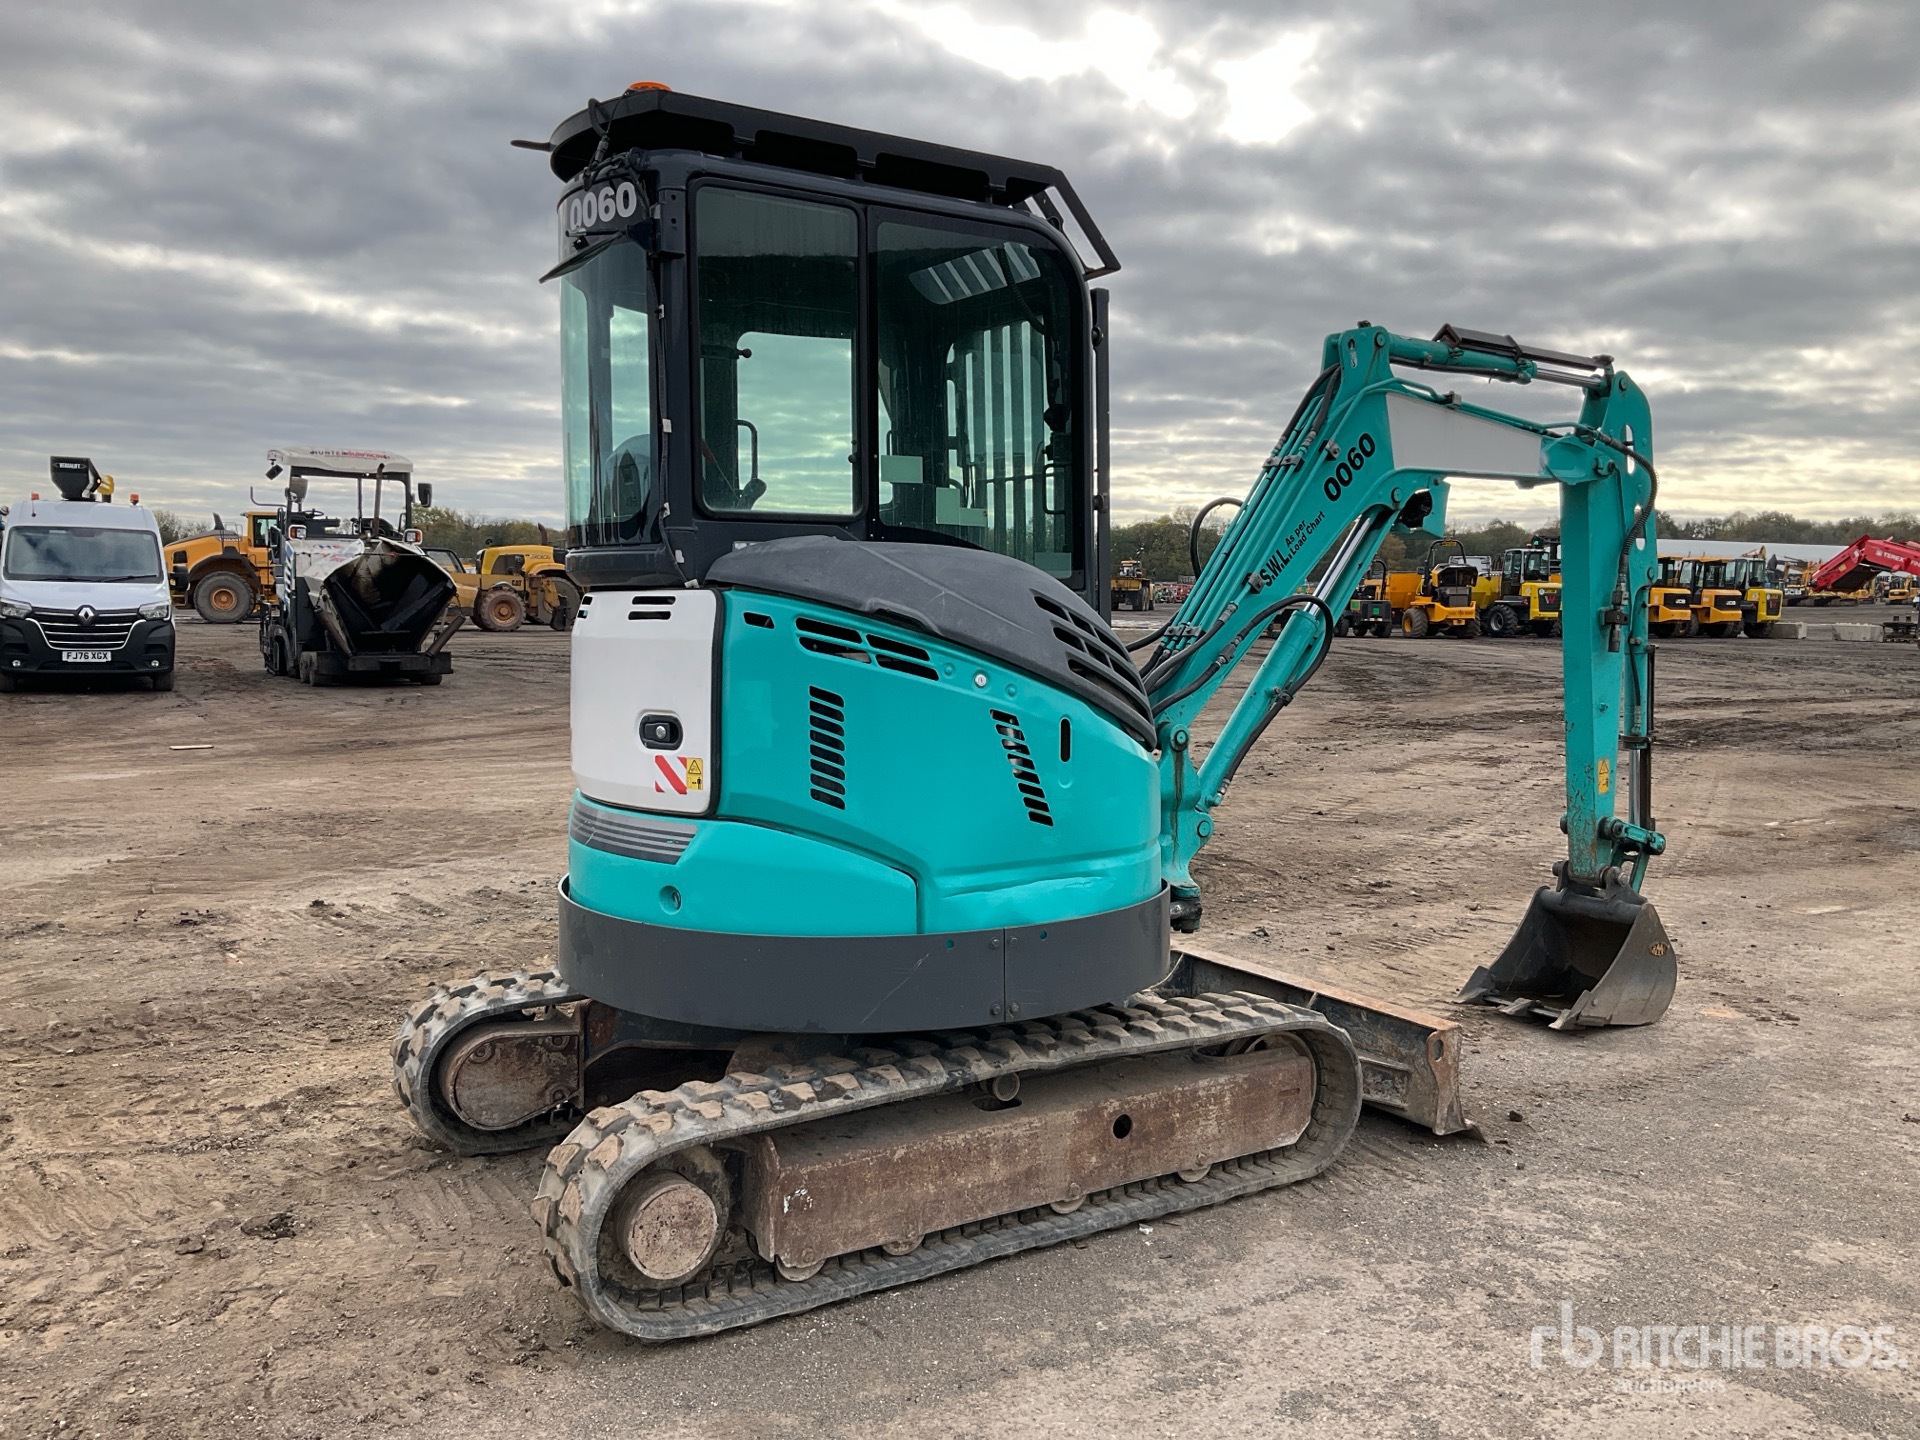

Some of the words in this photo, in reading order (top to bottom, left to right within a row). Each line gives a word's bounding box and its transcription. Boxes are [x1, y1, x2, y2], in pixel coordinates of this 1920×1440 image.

[570, 181, 637, 231] 0060
[1323, 432, 1376, 502] 0060
[1285, 534, 1295, 547] As
[1294, 519, 1306, 538] per
[1290, 532, 1307, 556] Load
[1306, 510, 1325, 535] Chart
[1259, 548, 1293, 587] S.W.L.
[1883, 551, 1905, 562] TEREX
[66, 651, 90, 660] FJ76
[91, 651, 108, 660] XGX
